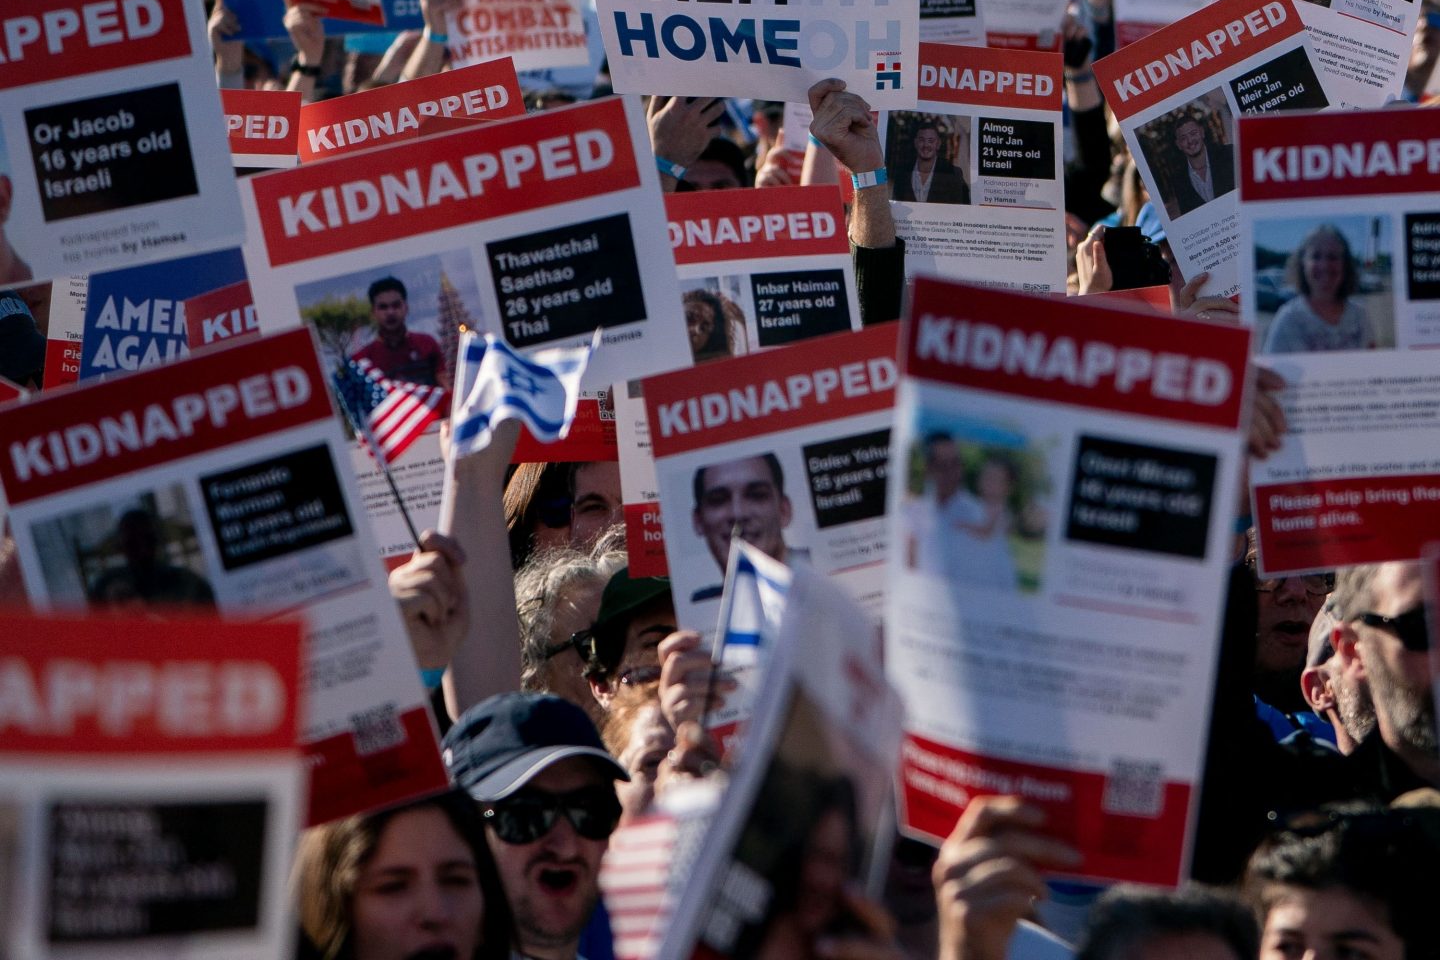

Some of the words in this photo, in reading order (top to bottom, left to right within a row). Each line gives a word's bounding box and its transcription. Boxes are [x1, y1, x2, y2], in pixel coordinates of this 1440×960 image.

[456, 8, 573, 38] COMBAT
[613, 11, 802, 69] HOME
[1113, 0, 1288, 102] KIDNAPPED
[1237, 72, 1269, 93] Almog
[1241, 89, 1262, 106] Meir
[1265, 80, 1283, 94] Jan
[1260, 93, 1287, 114] years
[1288, 83, 1305, 97] old
[33, 123, 63, 145] Or
[67, 110, 136, 141] Jacob
[983, 123, 1014, 135] Almog
[983, 135, 1004, 145] Meir
[1005, 137, 1023, 146] Jan
[39, 152, 66, 172] 16
[71, 139, 132, 171] years
[136, 130, 173, 154] old
[982, 147, 994, 156] 21
[996, 149, 1023, 158] years
[1025, 150, 1041, 159] old
[983, 159, 1012, 169] Israeli
[44, 170, 113, 200] Israeli
[278, 128, 615, 239] KIDNAPPED
[494, 233, 600, 271] Thawatchai
[500, 266, 575, 294] Saethao
[756, 281, 790, 295] Inbar
[792, 279, 840, 293] Haiman
[505, 296, 529, 318] 26
[530, 288, 582, 316] years
[584, 277, 614, 300] old
[758, 299, 775, 311] 27
[777, 299, 813, 314] years
[815, 296, 835, 308] old
[508, 315, 550, 340] Thai
[760, 315, 801, 329] Israeli
[915, 312, 1234, 408] KIDNAPPED
[657, 356, 898, 438] KIDNAPPED
[10, 365, 313, 482] KIDNAPPED
[1268, 493, 1322, 511] Please
[1325, 490, 1362, 506] help
[1365, 488, 1410, 504] bring
